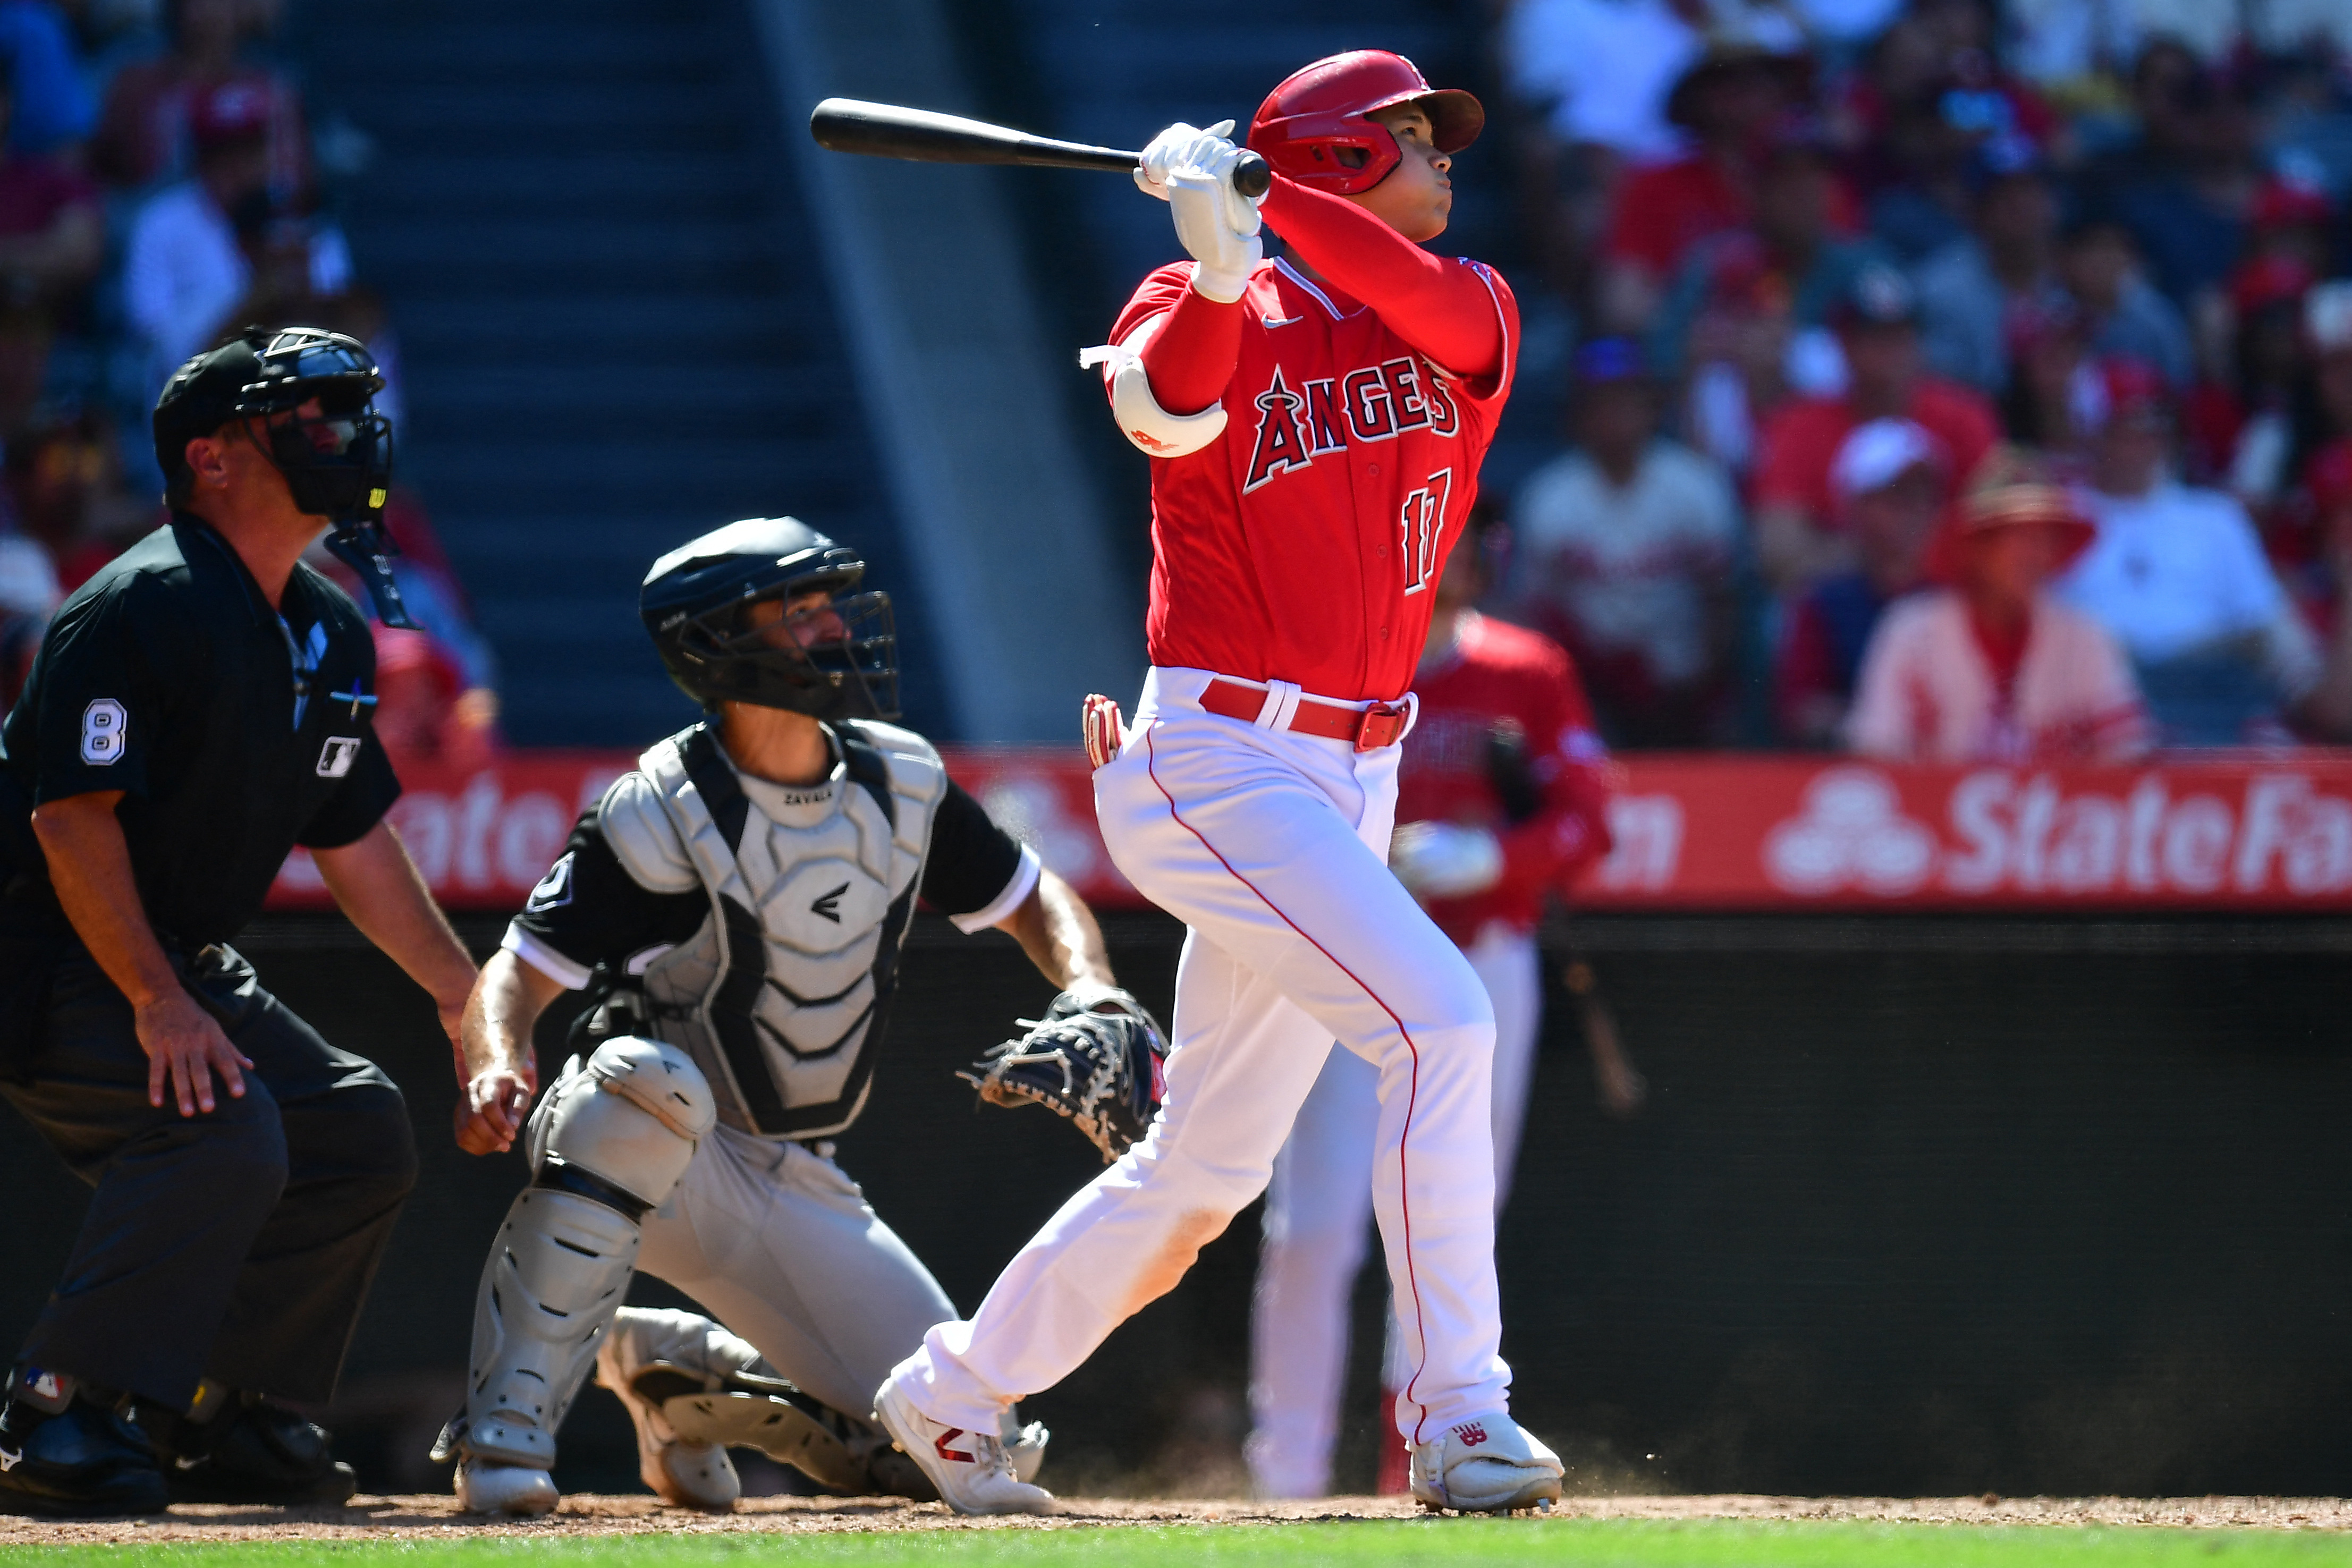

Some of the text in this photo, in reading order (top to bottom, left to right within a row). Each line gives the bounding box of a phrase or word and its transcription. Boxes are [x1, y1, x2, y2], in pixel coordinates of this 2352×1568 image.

[1242, 356, 1460, 496] ANGES
[1401, 467, 1452, 597] 17
[80, 698, 128, 766] 8
